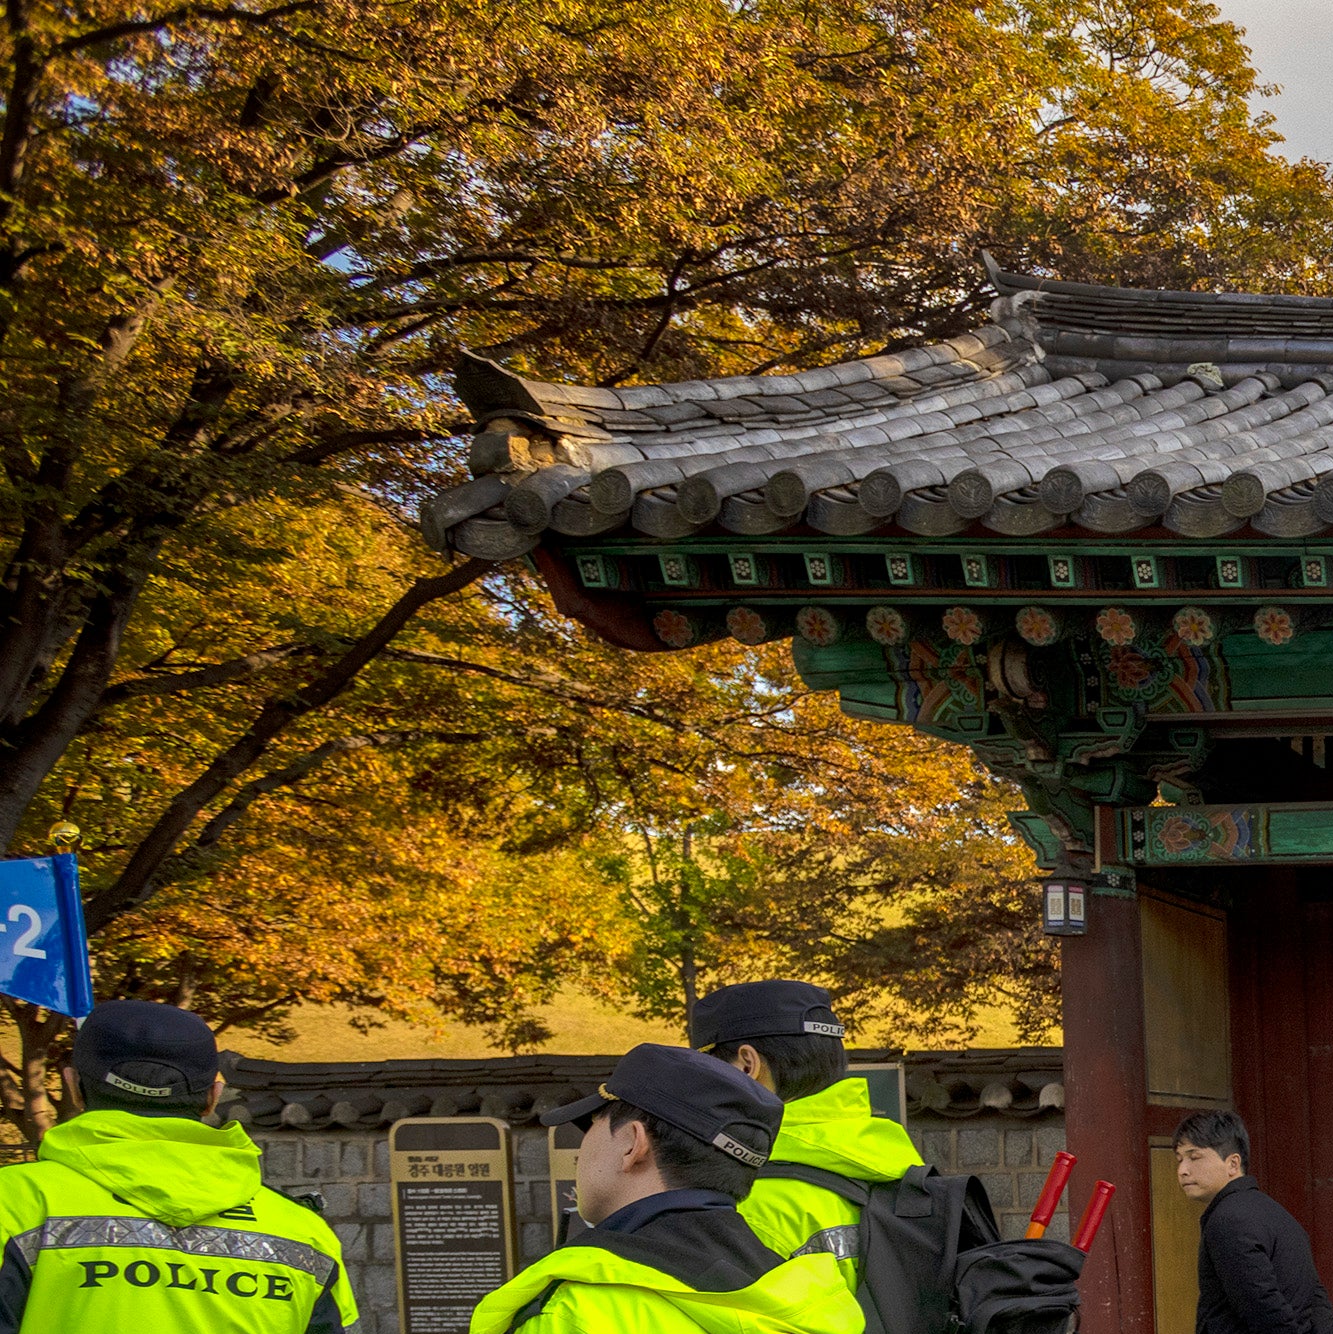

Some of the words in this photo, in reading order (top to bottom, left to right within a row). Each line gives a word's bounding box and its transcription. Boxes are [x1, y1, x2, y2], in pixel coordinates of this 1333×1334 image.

[114, 1078, 169, 1097] POLICE
[723, 1141, 765, 1166] POLICE
[77, 1260, 295, 1302] POLICE
